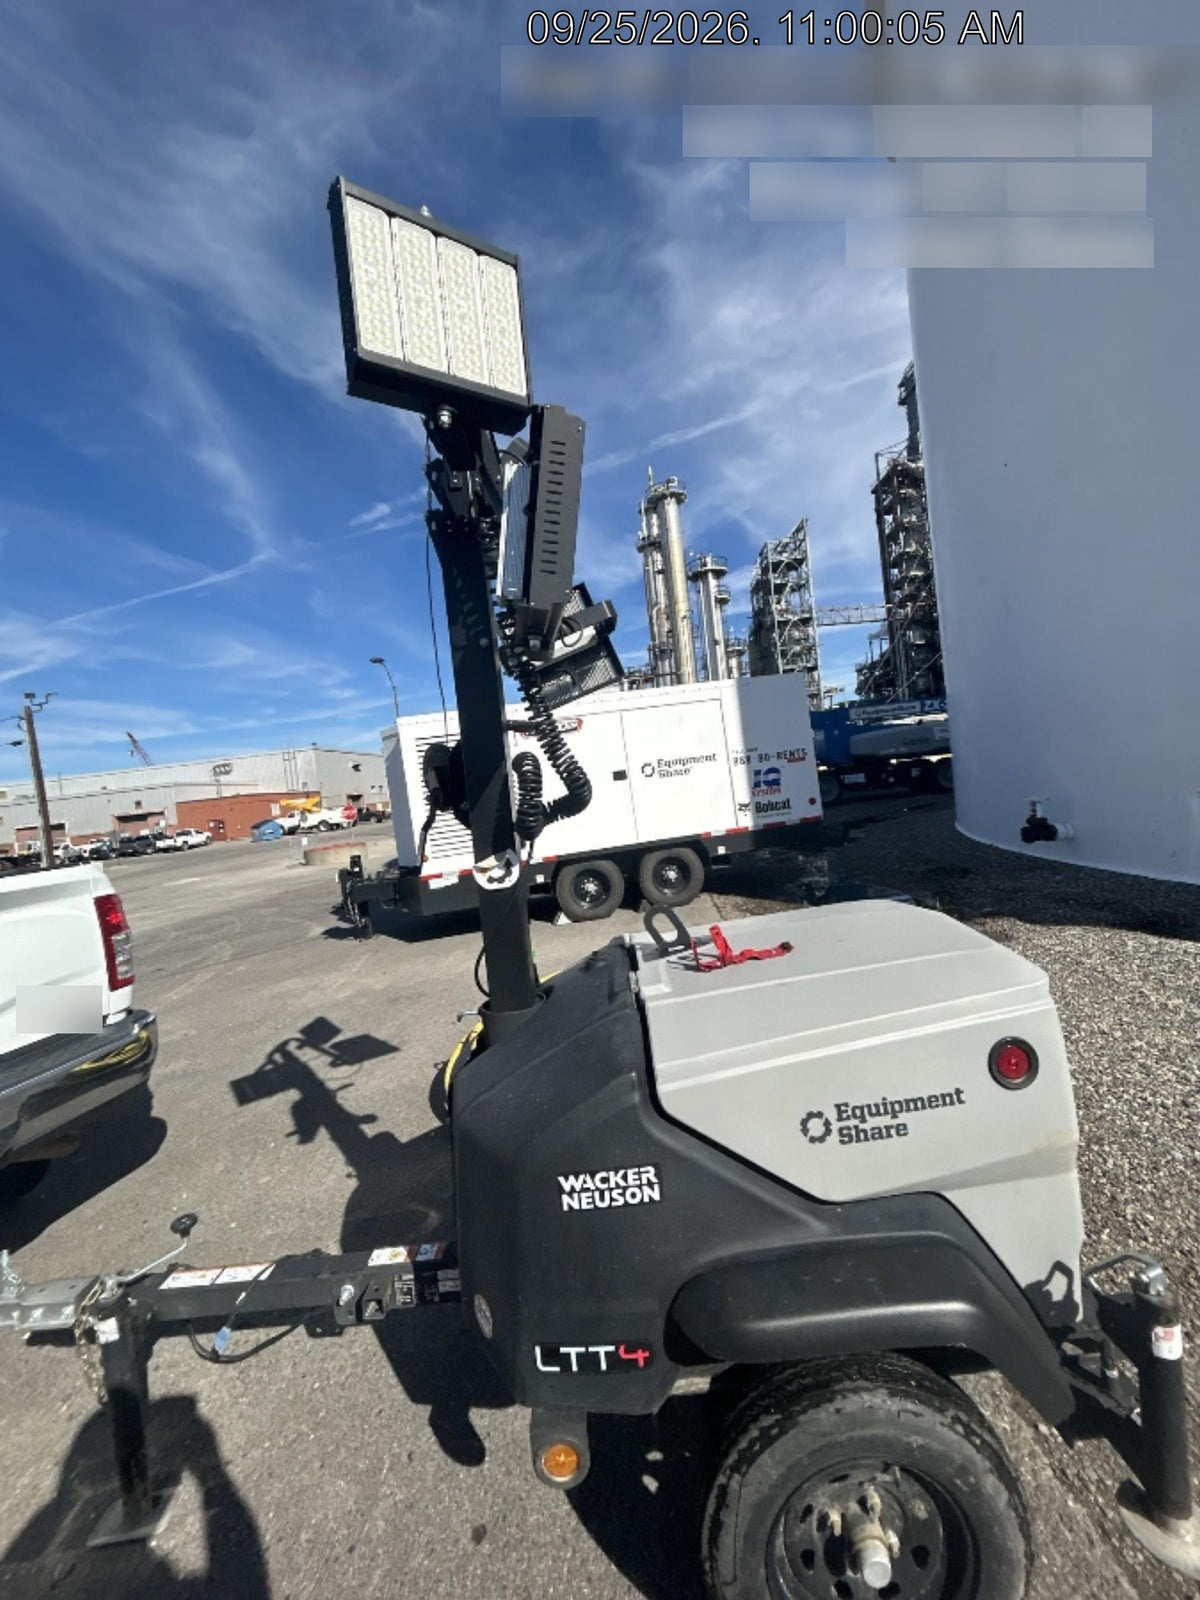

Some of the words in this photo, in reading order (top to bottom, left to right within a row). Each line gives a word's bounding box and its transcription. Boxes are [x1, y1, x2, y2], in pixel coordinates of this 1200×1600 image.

[656, 753, 717, 768] Equipment
[755, 798, 792, 813] Bobcat
[834, 1087, 966, 1124] Equipment
[837, 1122, 909, 1145] Share
[557, 1165, 660, 1193] WACKER
[560, 1184, 661, 1212] NEUSON
[534, 1343, 650, 1372] LTT4
